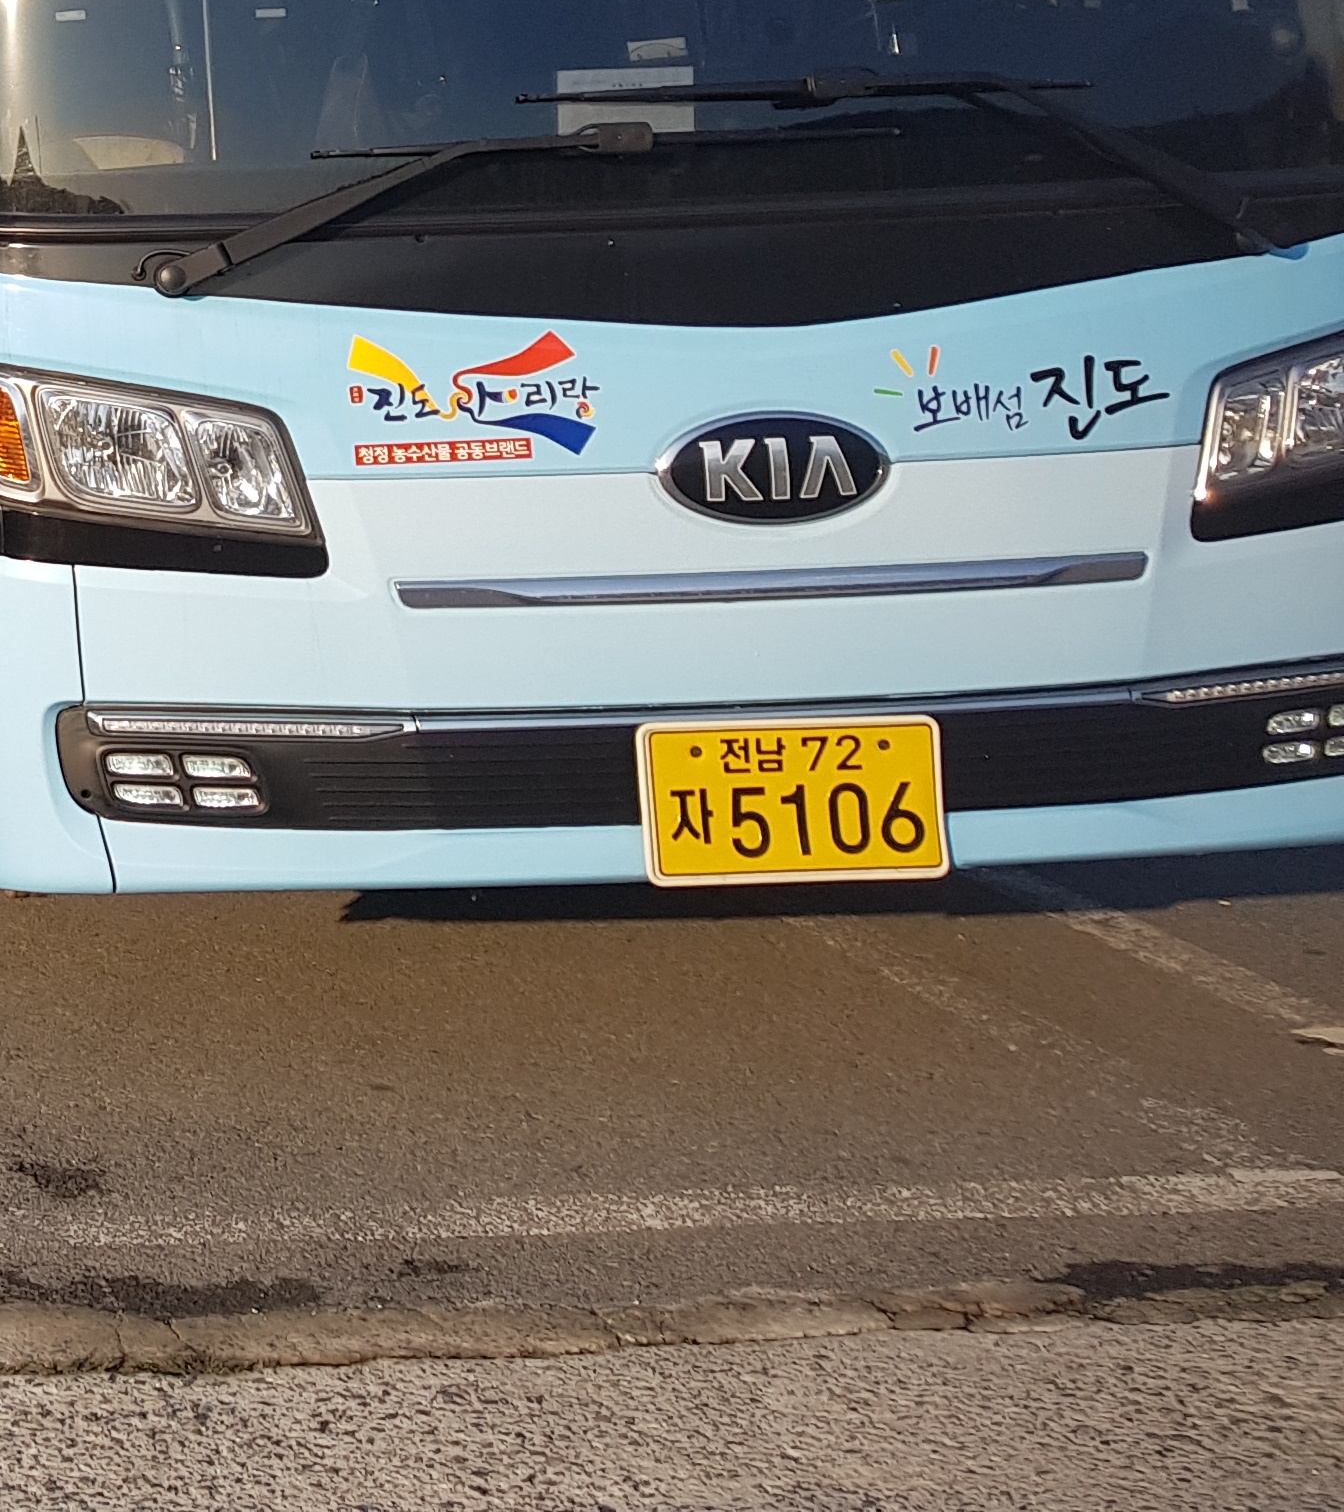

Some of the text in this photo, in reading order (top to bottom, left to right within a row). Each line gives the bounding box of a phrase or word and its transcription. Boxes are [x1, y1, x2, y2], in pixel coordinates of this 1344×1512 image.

[914, 354, 1171, 440] 보배섬 진도
[358, 439, 530, 463] 청정 농수산물 공동브랜드
[699, 434, 858, 502] KIA
[719, 734, 863, 774] 전남 72
